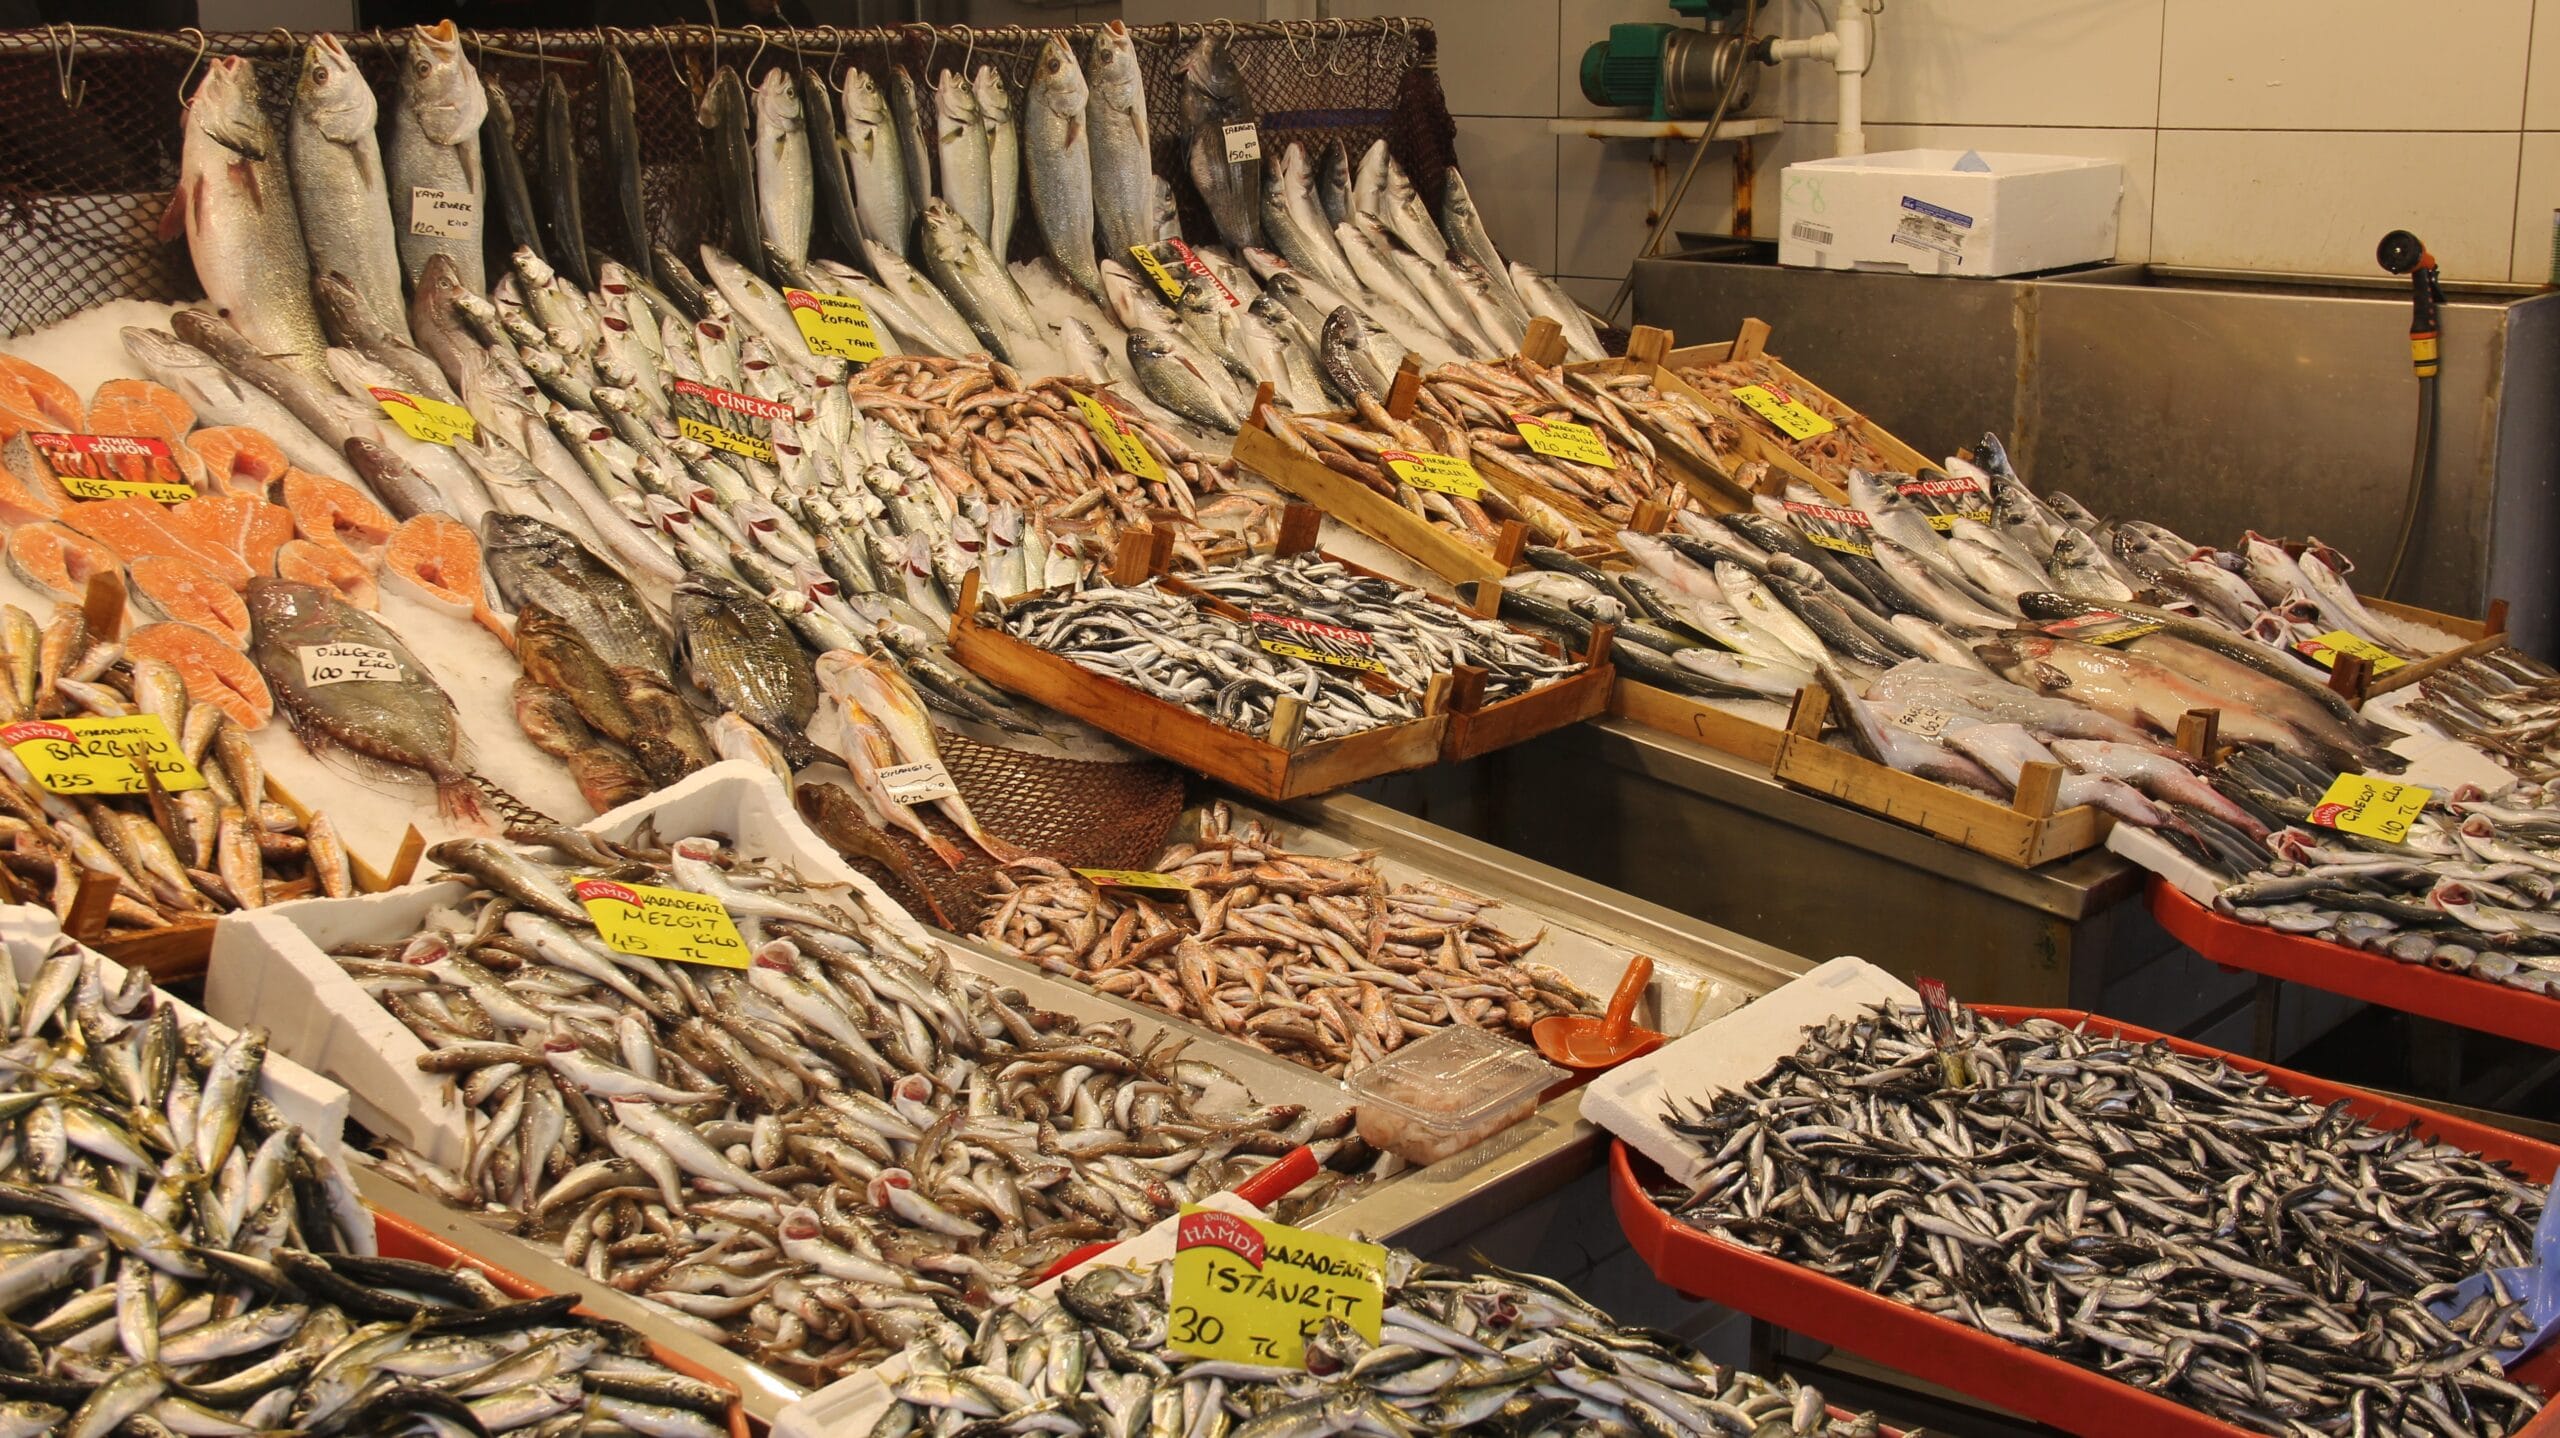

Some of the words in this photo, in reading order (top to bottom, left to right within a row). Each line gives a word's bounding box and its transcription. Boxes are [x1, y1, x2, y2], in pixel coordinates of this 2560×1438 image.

[413, 221, 435, 234] 120
[820, 313, 869, 329] KOFANA
[809, 336, 833, 353] 95
[845, 338, 880, 350] TANE
[414, 423, 448, 442] 100
[684, 422, 716, 443] 125
[87, 442, 153, 456] SOMON
[1534, 439, 1560, 453] 120
[75, 480, 116, 498] 185
[1810, 504, 1869, 525] LEVREK
[1928, 517, 1950, 529] 35
[1270, 643, 1297, 655] 65
[311, 666, 344, 682] 100
[349, 670, 379, 680] TL
[44, 772, 95, 789] 135
[612, 932, 649, 950] 45
[679, 947, 709, 959] TL
[1183, 1224, 1260, 1258] HAMDİ
[1172, 1305, 1225, 1345] 30
[1248, 1336, 1281, 1359] TL
